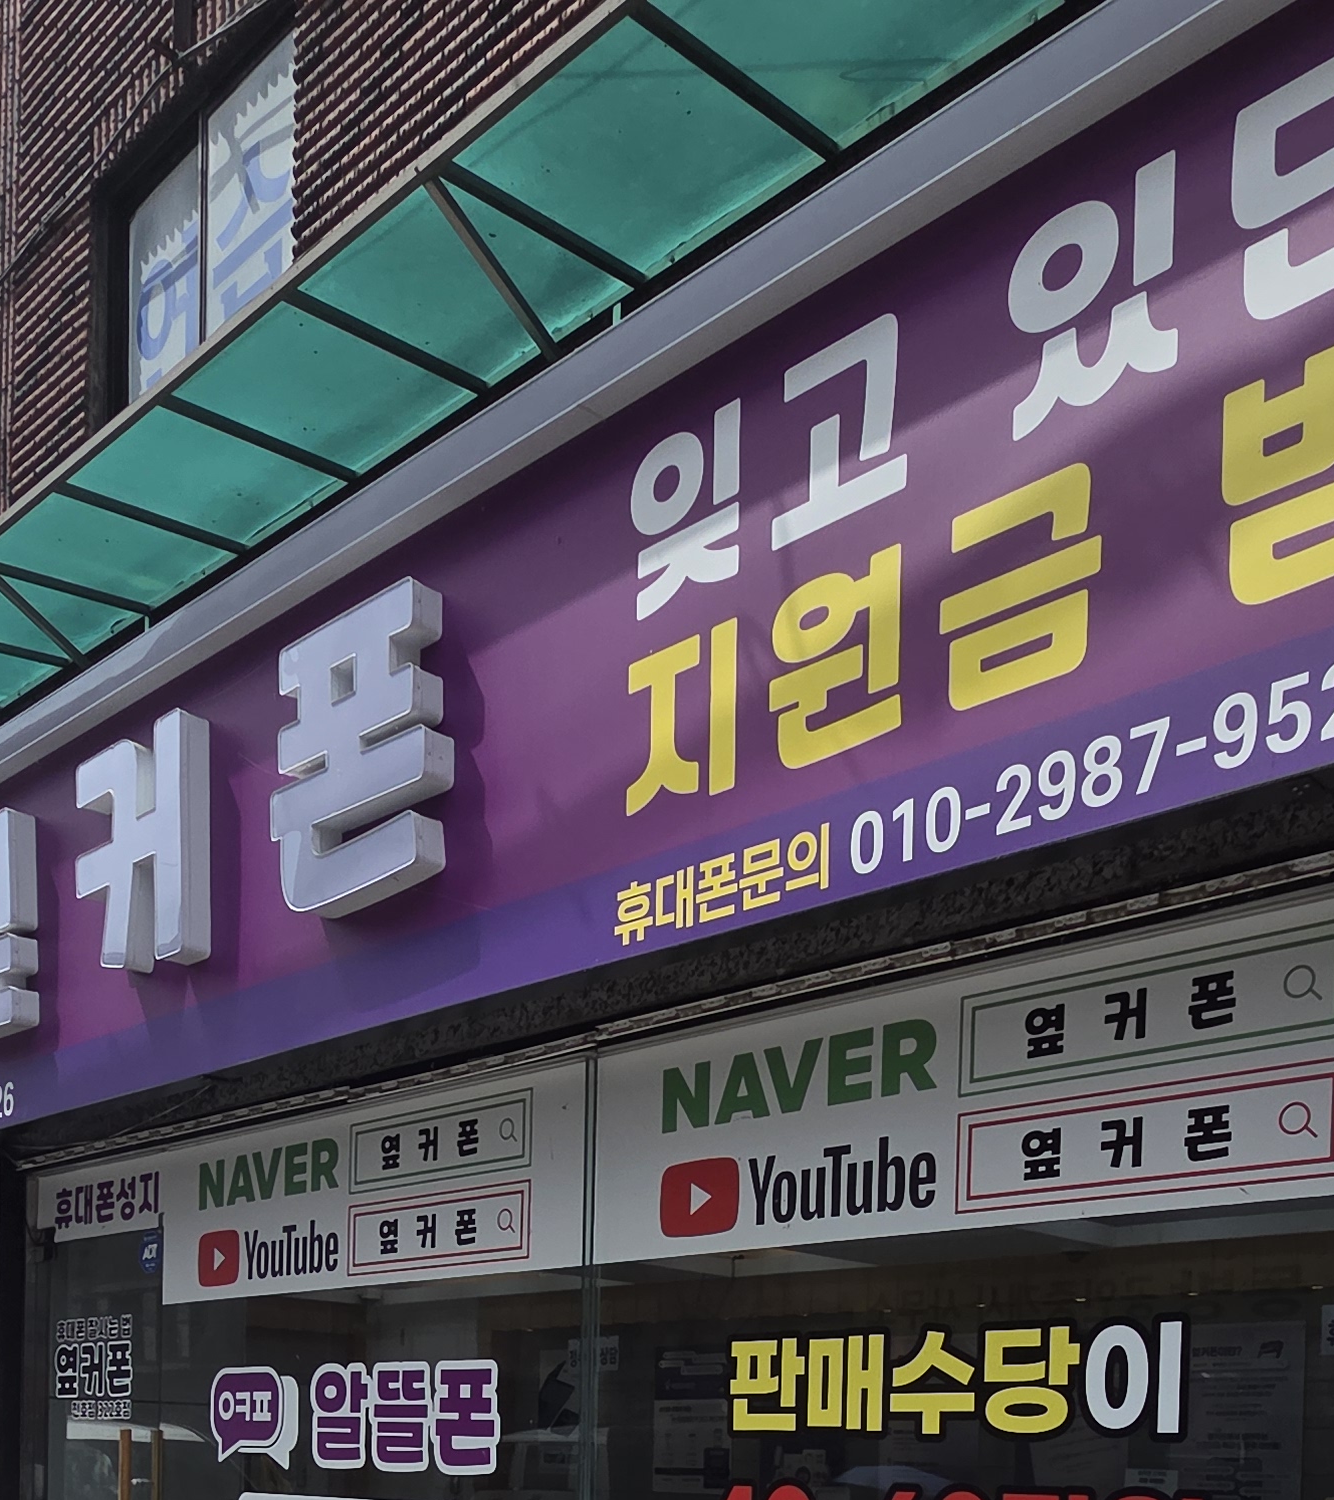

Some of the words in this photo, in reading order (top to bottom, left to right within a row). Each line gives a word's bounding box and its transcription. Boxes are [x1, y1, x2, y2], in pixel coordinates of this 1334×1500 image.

[630, 312, 909, 621] 잊고
[625, 461, 1103, 817] 지원금
[613, 820, 832, 947] 휴대폰문의
[659, 1017, 939, 1135] NAVER
[54, 1170, 161, 1231] 휴대폰성지
[197, 1137, 341, 1212] NAVER
[747, 1136, 938, 1226] YouTube
[244, 1219, 340, 1282] YouTube
[54, 1340, 133, 1398] 옆커폰
[312, 1361, 499, 1474] 알뜰폰
[729, 1319, 1184, 1434] 판매수당이
